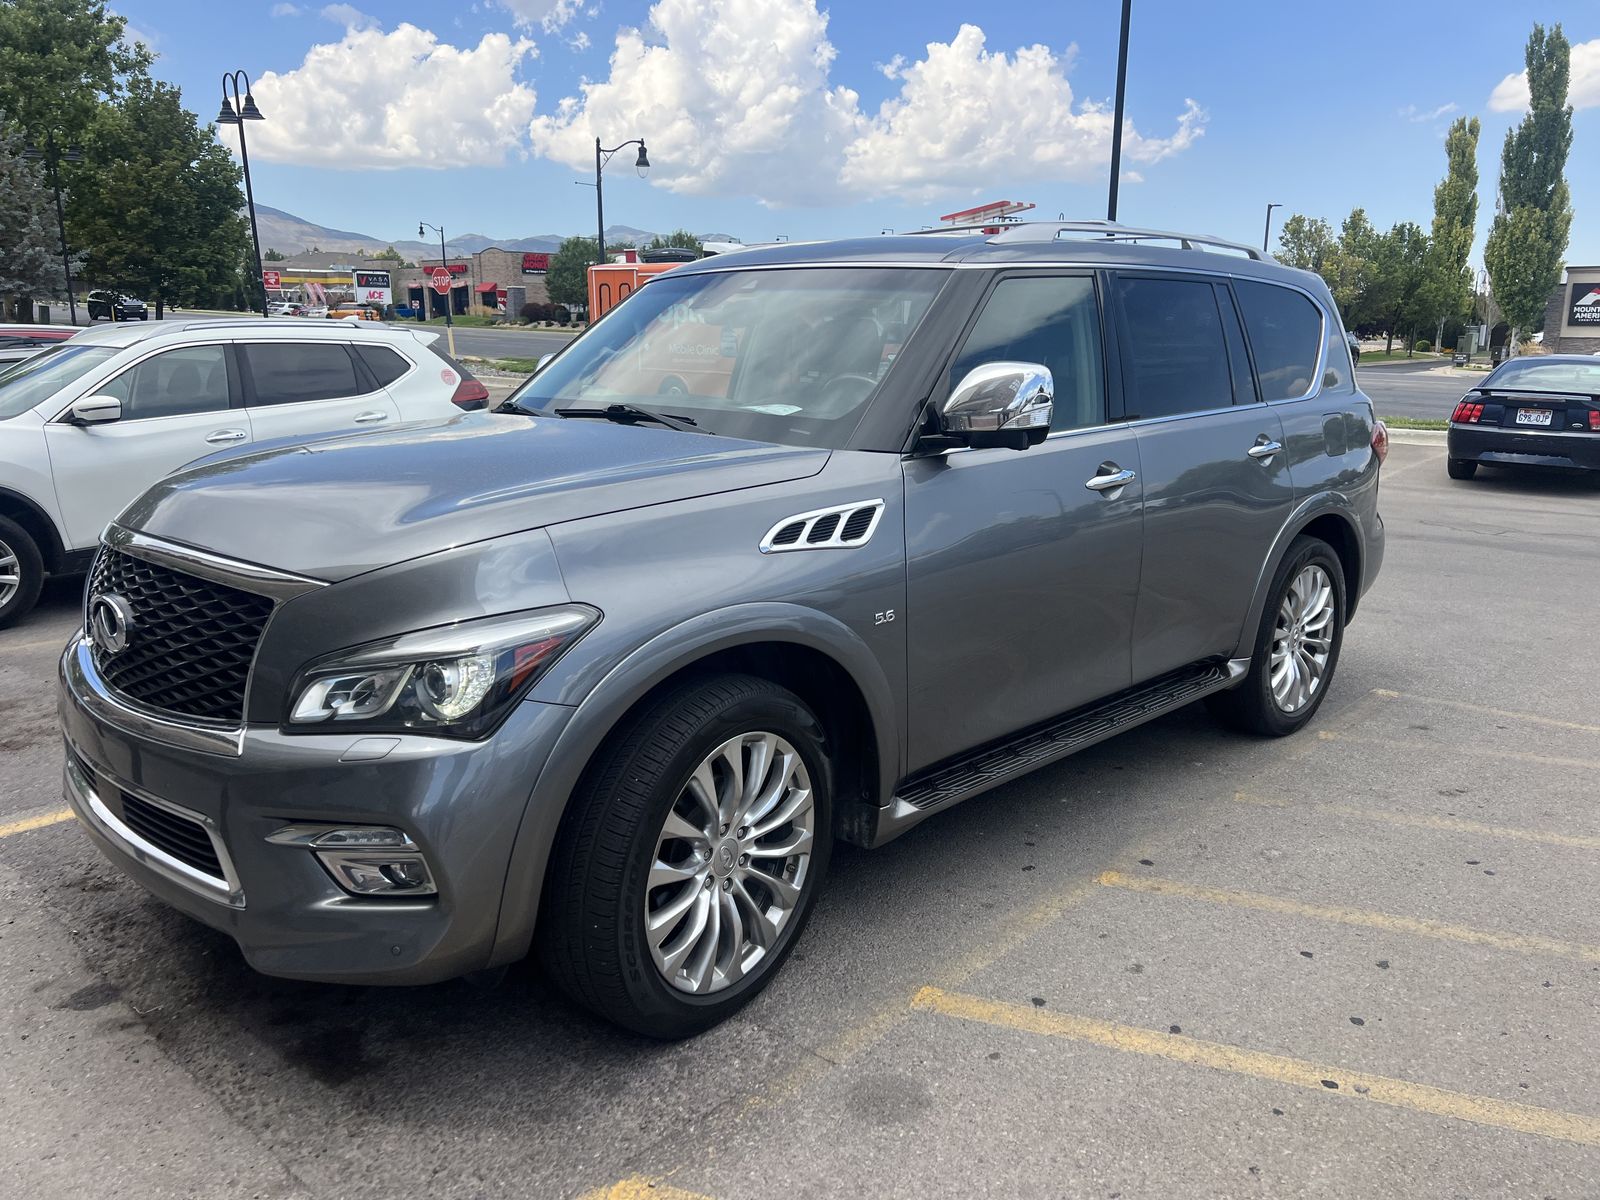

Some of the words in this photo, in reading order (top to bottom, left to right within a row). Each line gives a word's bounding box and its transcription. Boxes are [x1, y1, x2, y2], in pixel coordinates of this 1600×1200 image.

[433, 276, 449, 286] STOP
[366, 290, 384, 299] ACE
[669, 343, 695, 353] Mobile
[696, 343, 720, 353] Clinic
[875, 609, 895, 625] 5.6
